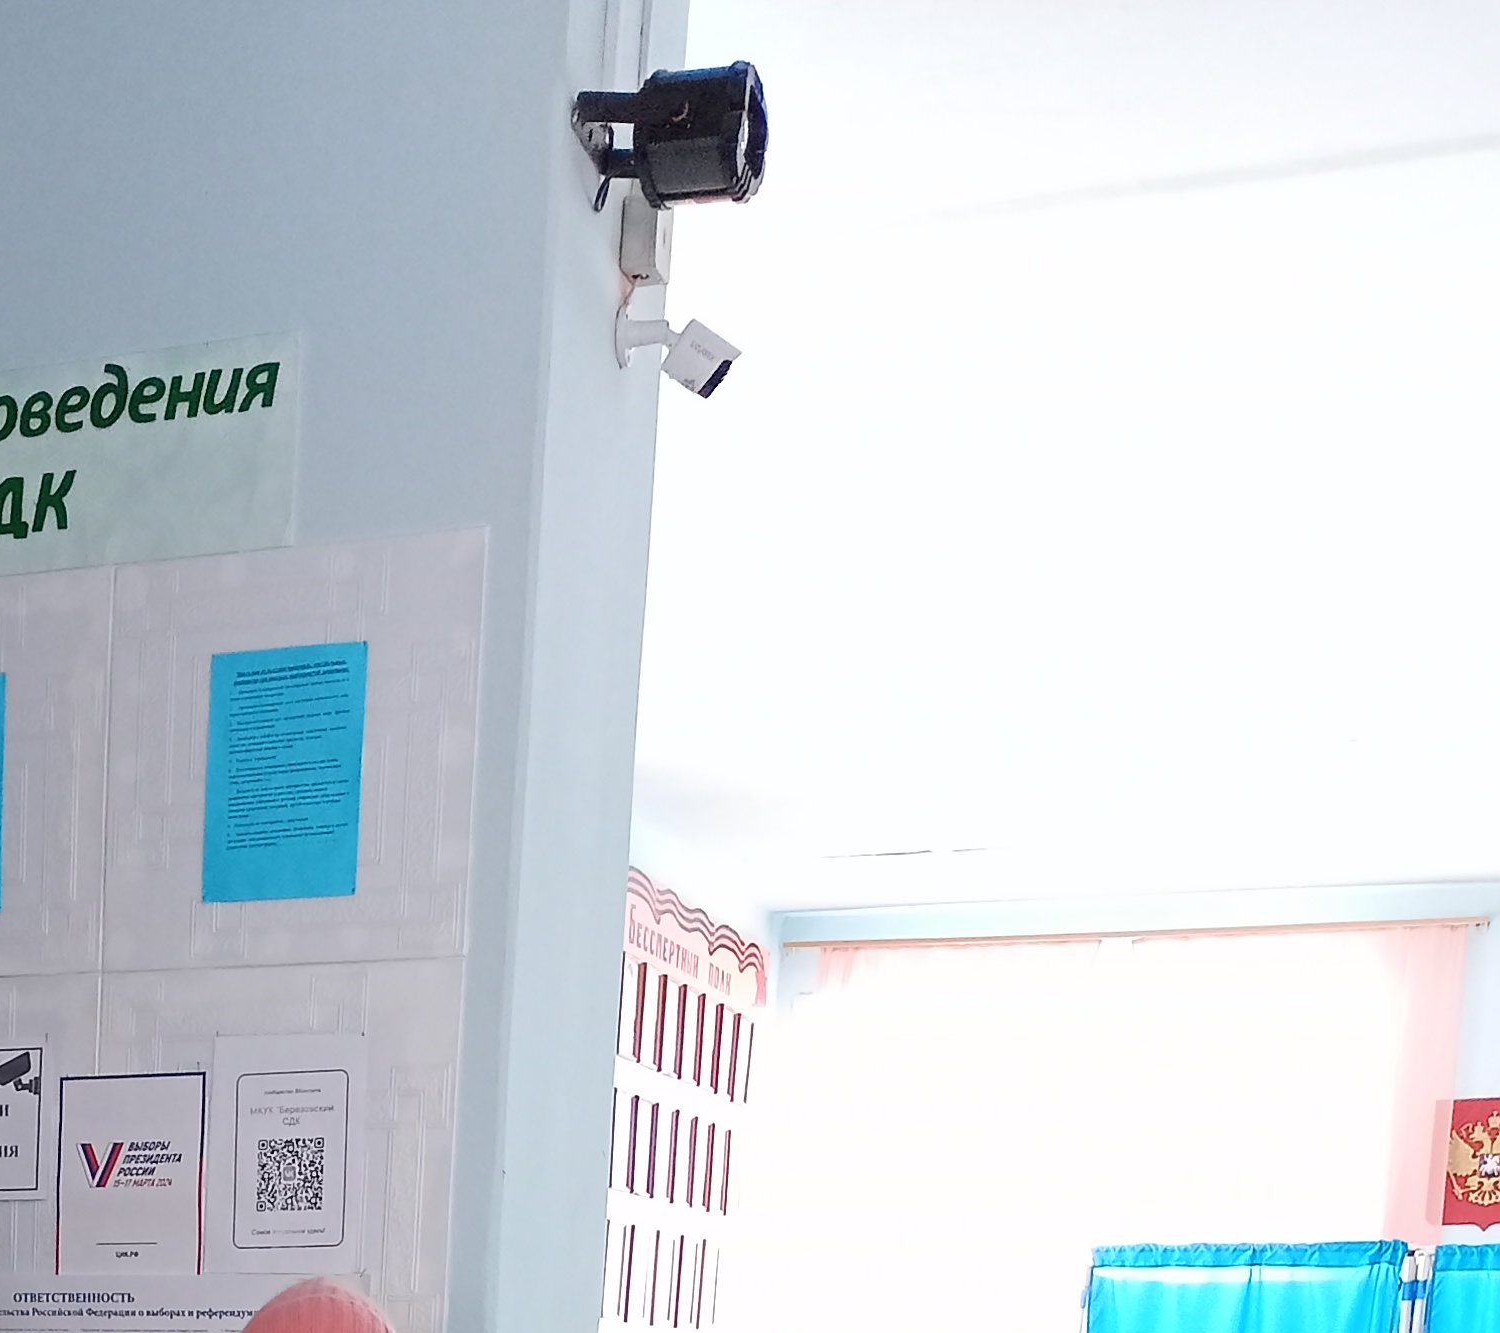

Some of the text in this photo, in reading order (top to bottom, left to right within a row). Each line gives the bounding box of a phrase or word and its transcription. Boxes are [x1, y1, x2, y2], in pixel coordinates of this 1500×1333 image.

[282, 1117, 300, 1126] СДК
[127, 1141, 171, 1152] ВЫБОРЫ
[122, 1153, 182, 1165] ПРЕЗИДЕНТА
[117, 1166, 156, 1177] РОССИИ
[132, 1178, 155, 1187] МАРТА
[13, 1292, 135, 1303] ОТВЕТСТВЕННОСТЬ
[31, 1307, 84, 1317] Российской
[86, 1307, 136, 1319] Федерации
[146, 1307, 185, 1319] выборах
[187, 1309, 194, 1317] и
